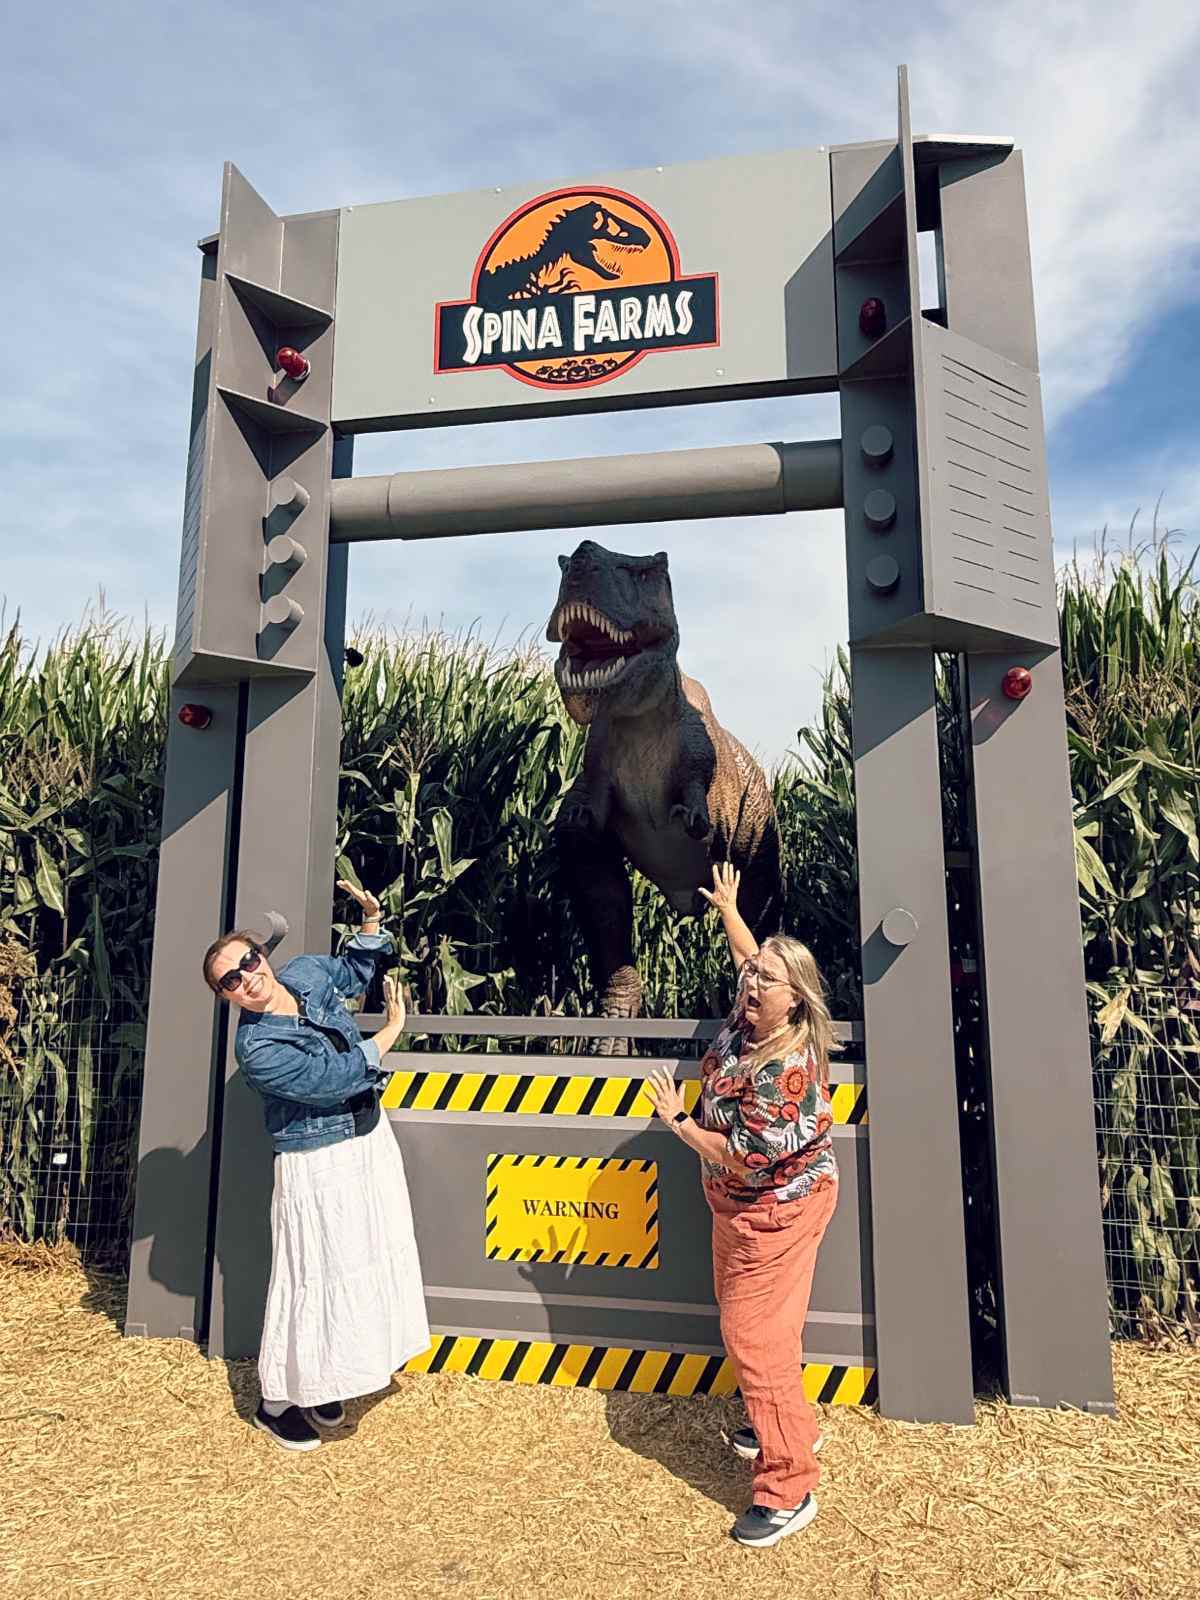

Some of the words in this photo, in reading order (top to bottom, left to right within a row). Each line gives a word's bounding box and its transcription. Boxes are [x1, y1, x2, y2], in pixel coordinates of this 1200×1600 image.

[462, 306, 562, 364] SPINA
[573, 291, 693, 351] FARMS
[523, 1199, 619, 1219] WARNING
